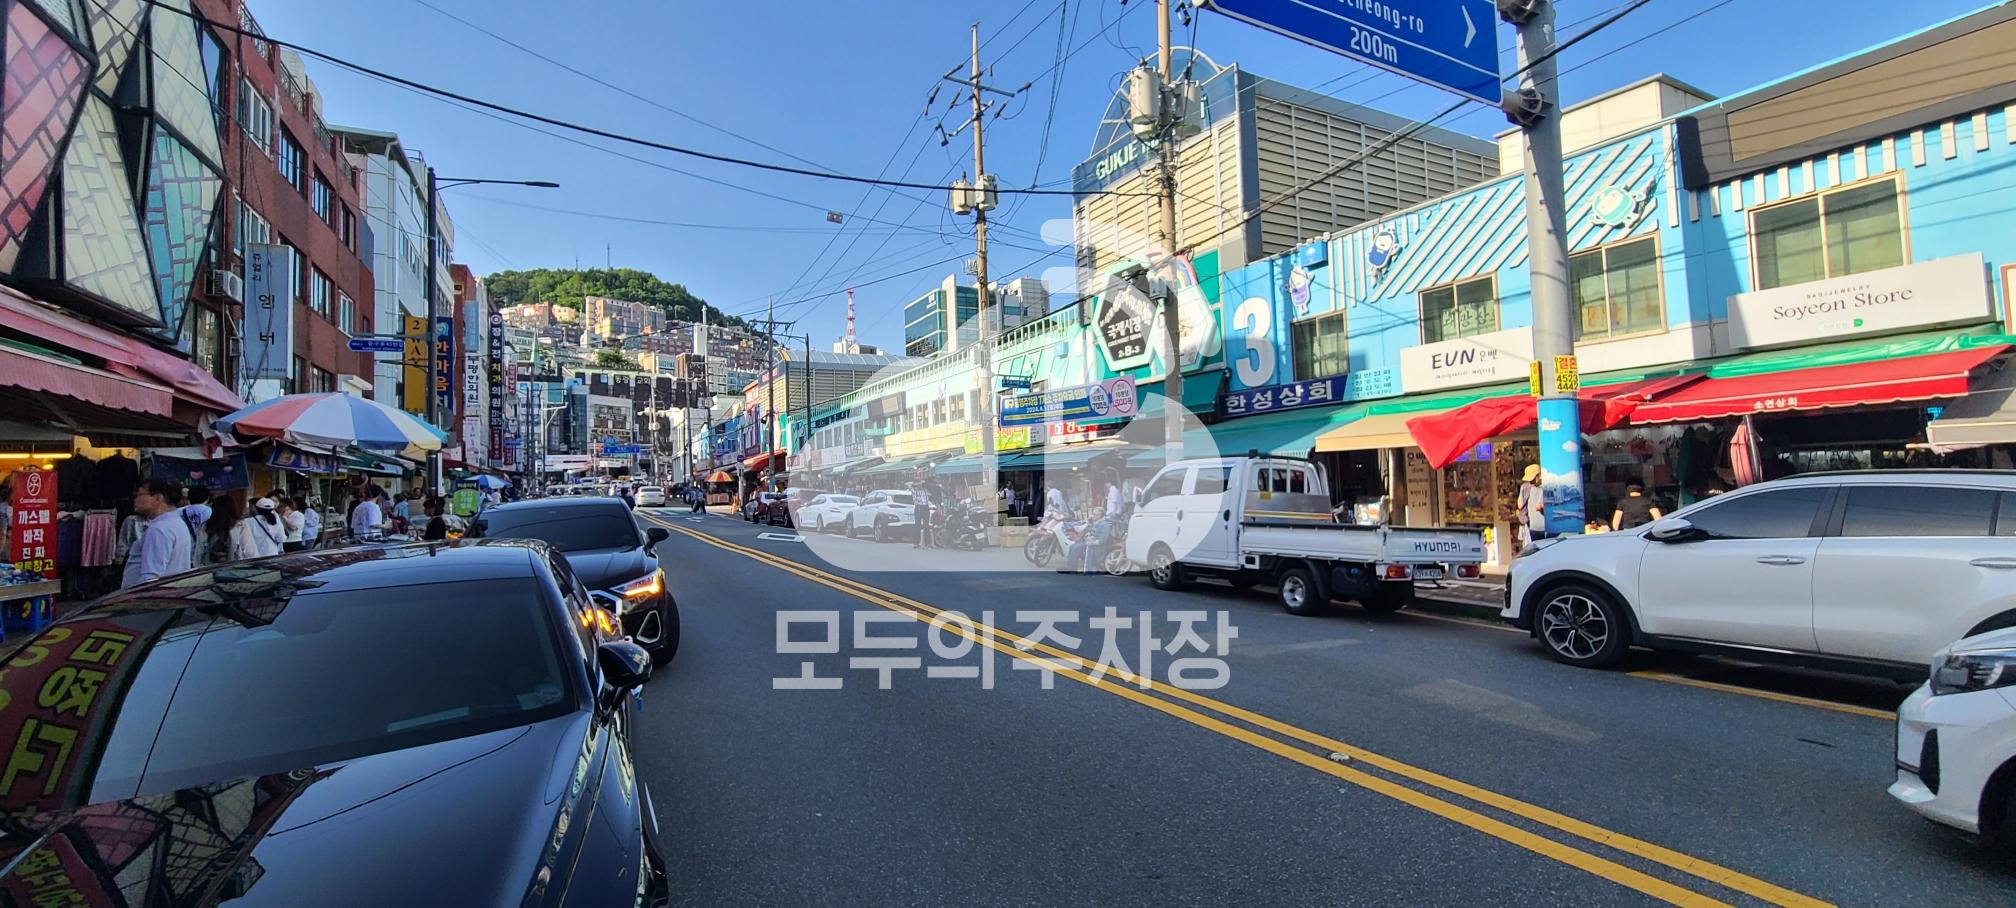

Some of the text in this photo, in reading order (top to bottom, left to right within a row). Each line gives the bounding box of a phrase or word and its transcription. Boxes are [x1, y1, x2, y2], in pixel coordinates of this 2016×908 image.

[1338, 0, 1424, 33] heong-ro
[1350, 26, 1398, 63] 200m
[1096, 139, 1138, 180] GUKJE
[1773, 289, 1913, 321] Soyeon Store
[1107, 316, 1141, 339] 국제시장
[1233, 296, 1276, 387] 3
[1432, 348, 1475, 369] EUN
[1226, 380, 1332, 413] 한성상회
[1754, 396, 1798, 410] 소연상회
[1414, 542, 1461, 552] HYUNDAI
